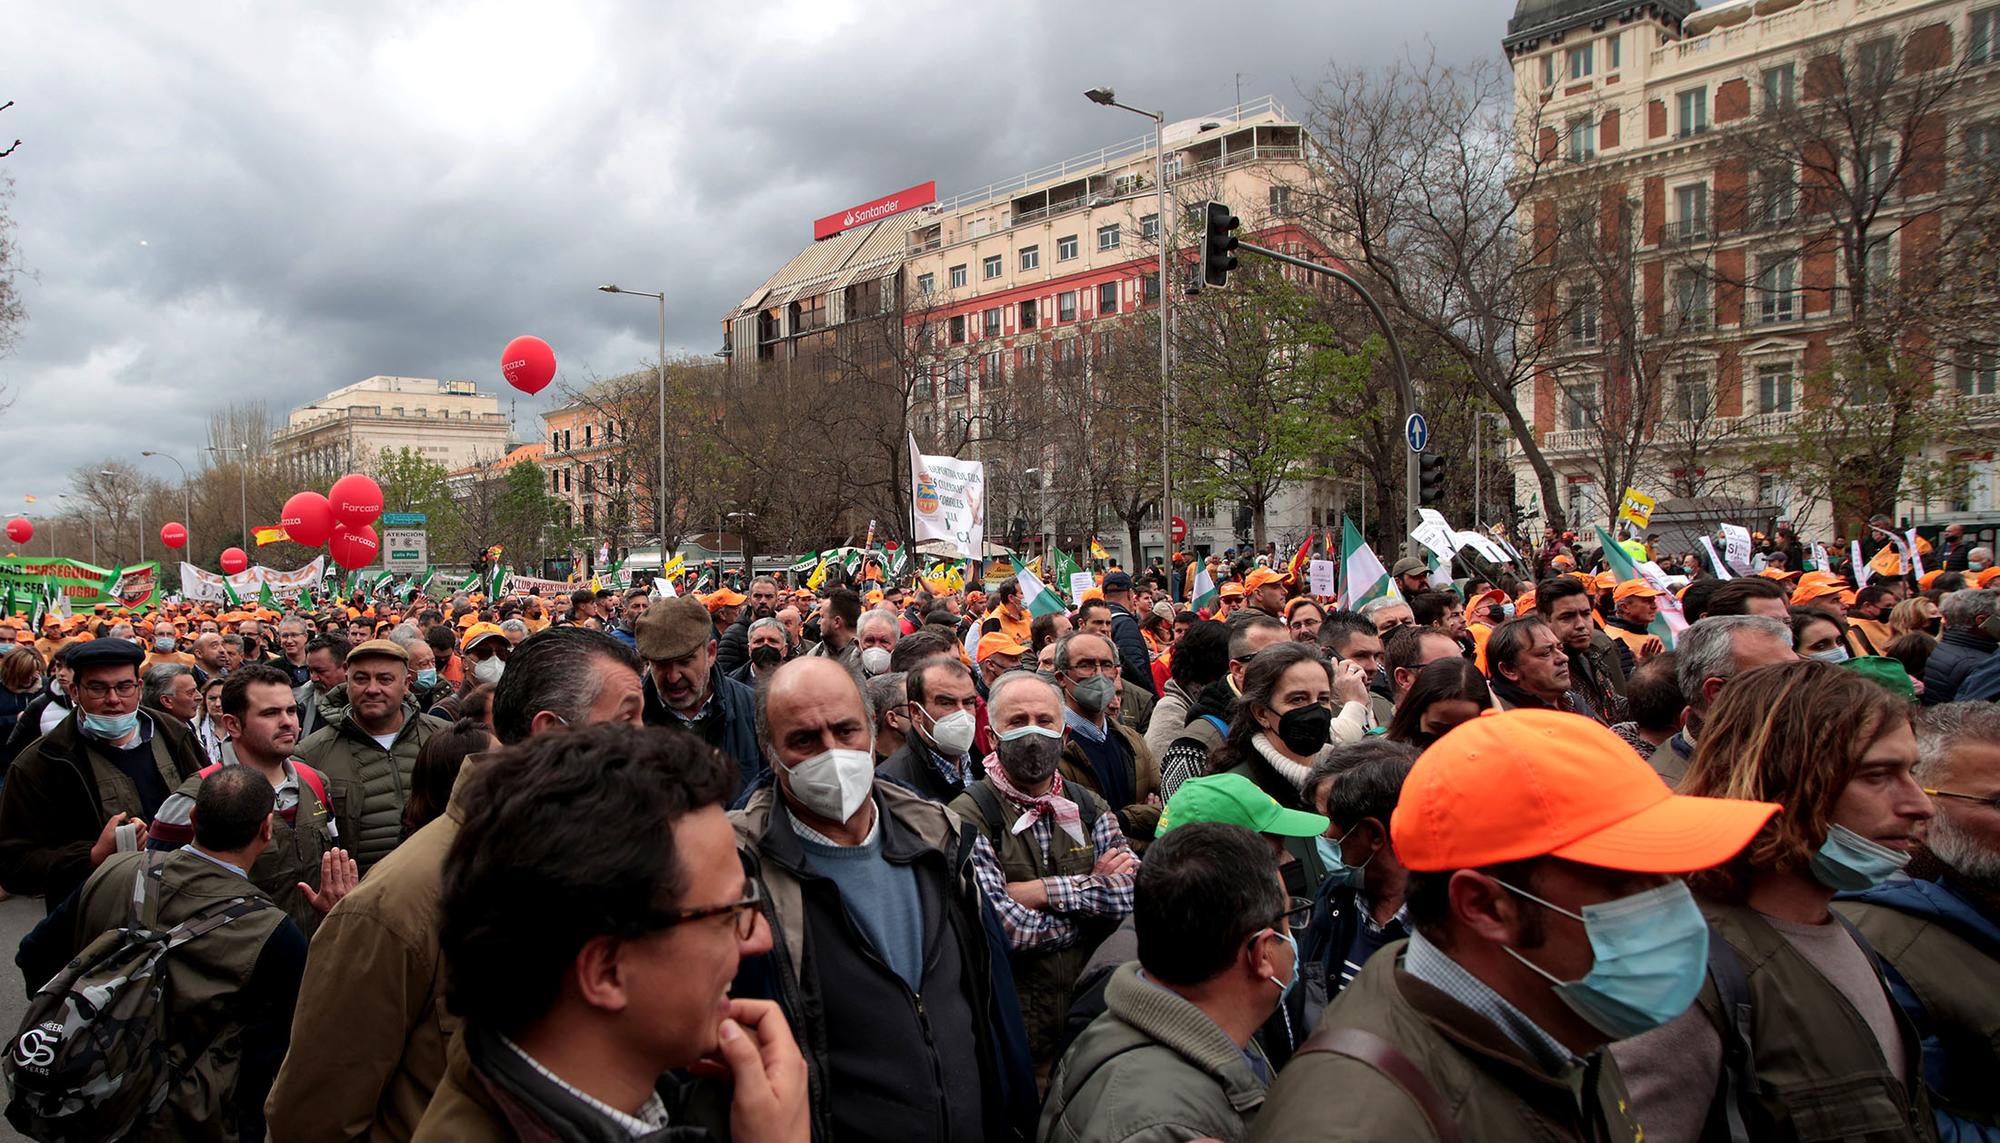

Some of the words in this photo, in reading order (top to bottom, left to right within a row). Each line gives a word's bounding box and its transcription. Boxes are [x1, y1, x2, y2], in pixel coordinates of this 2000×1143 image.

[855, 200, 899, 223] Santander
[342, 502, 379, 513] Farcaza
[343, 532, 376, 549] Farcaza
[514, 579, 531, 590] CLUB
[63, 585, 98, 598] LOGRO
